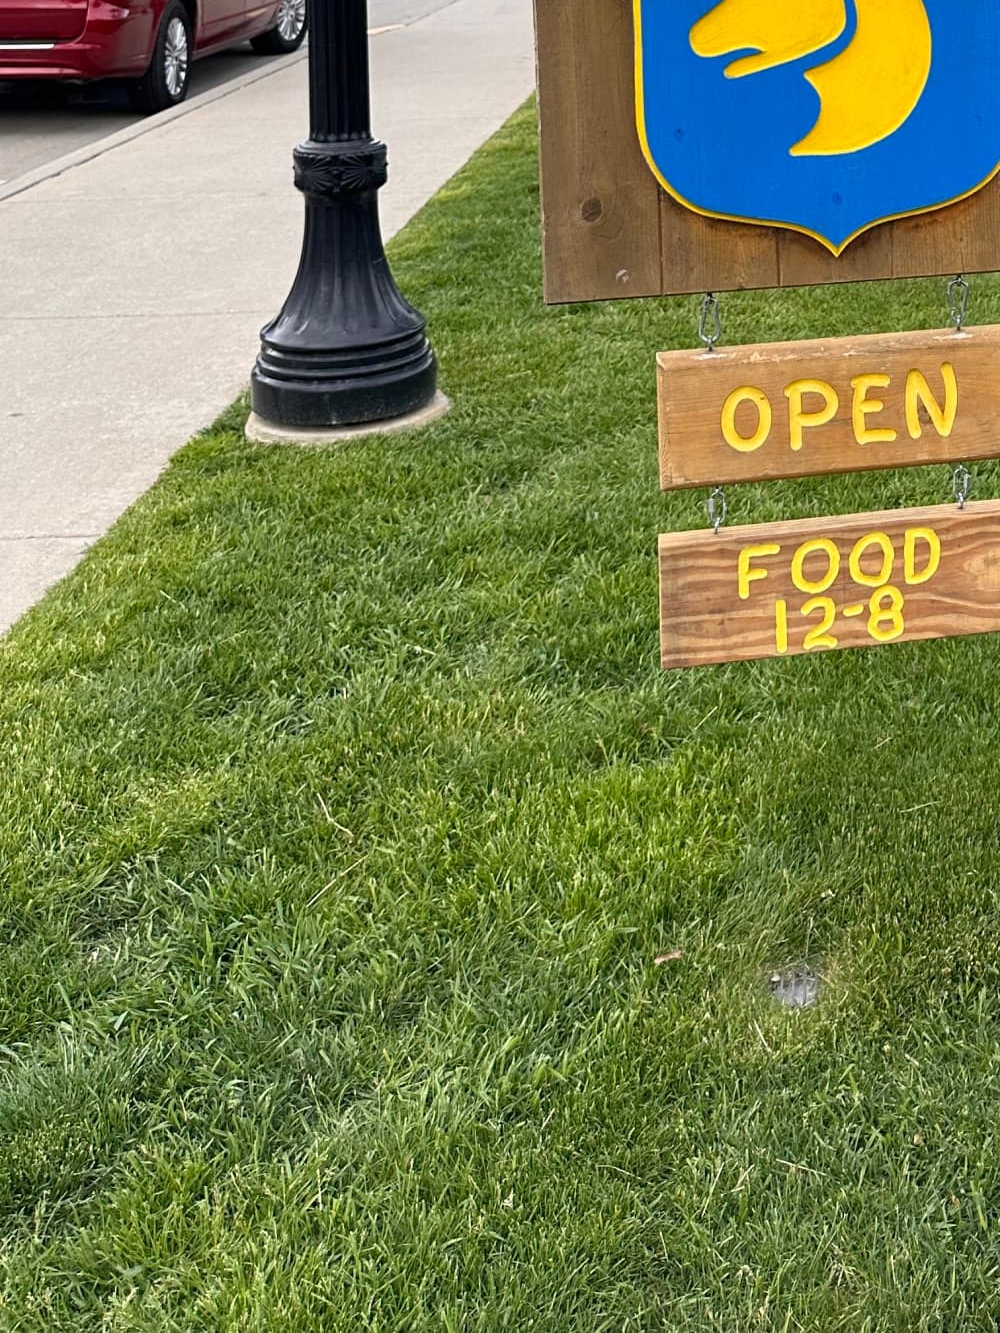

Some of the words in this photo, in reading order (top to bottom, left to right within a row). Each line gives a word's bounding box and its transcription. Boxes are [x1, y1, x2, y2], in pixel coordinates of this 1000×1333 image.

[720, 361, 959, 453] OPEN
[737, 527, 941, 599] FOOD
[774, 584, 905, 654] 12-8
